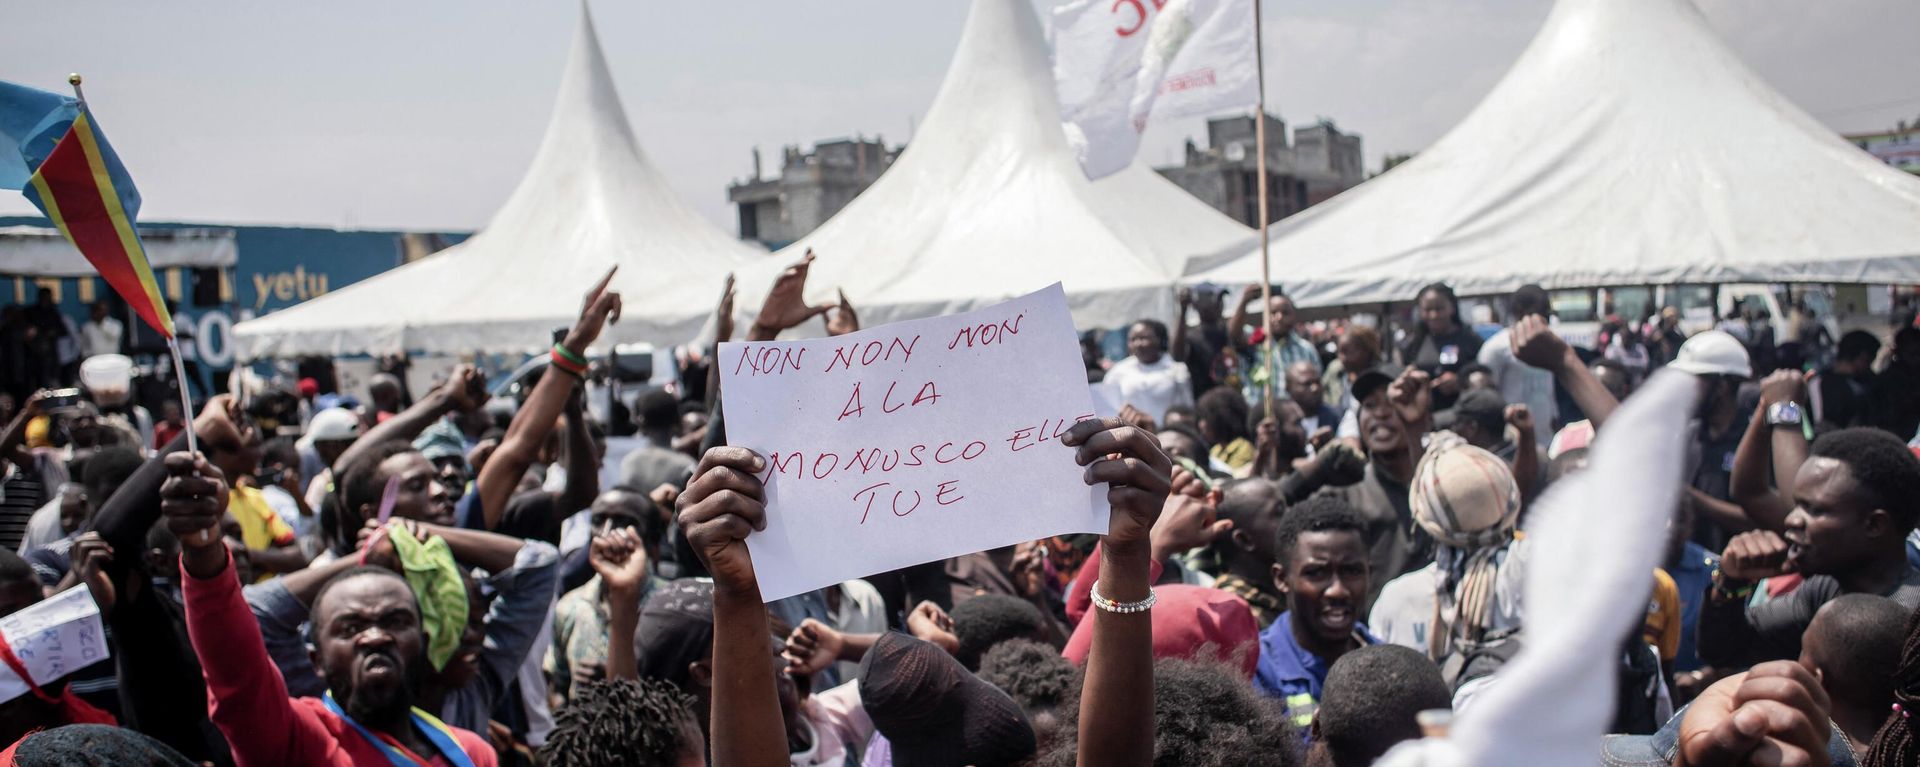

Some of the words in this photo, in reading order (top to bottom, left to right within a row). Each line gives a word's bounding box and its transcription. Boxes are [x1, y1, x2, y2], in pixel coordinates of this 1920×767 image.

[253, 264, 328, 310] yetu
[735, 345, 805, 375] NON
[825, 335, 920, 373] NON
[948, 313, 1024, 350] NON
[764, 441, 986, 486] MONUSCO
[853, 480, 965, 525] TUE
